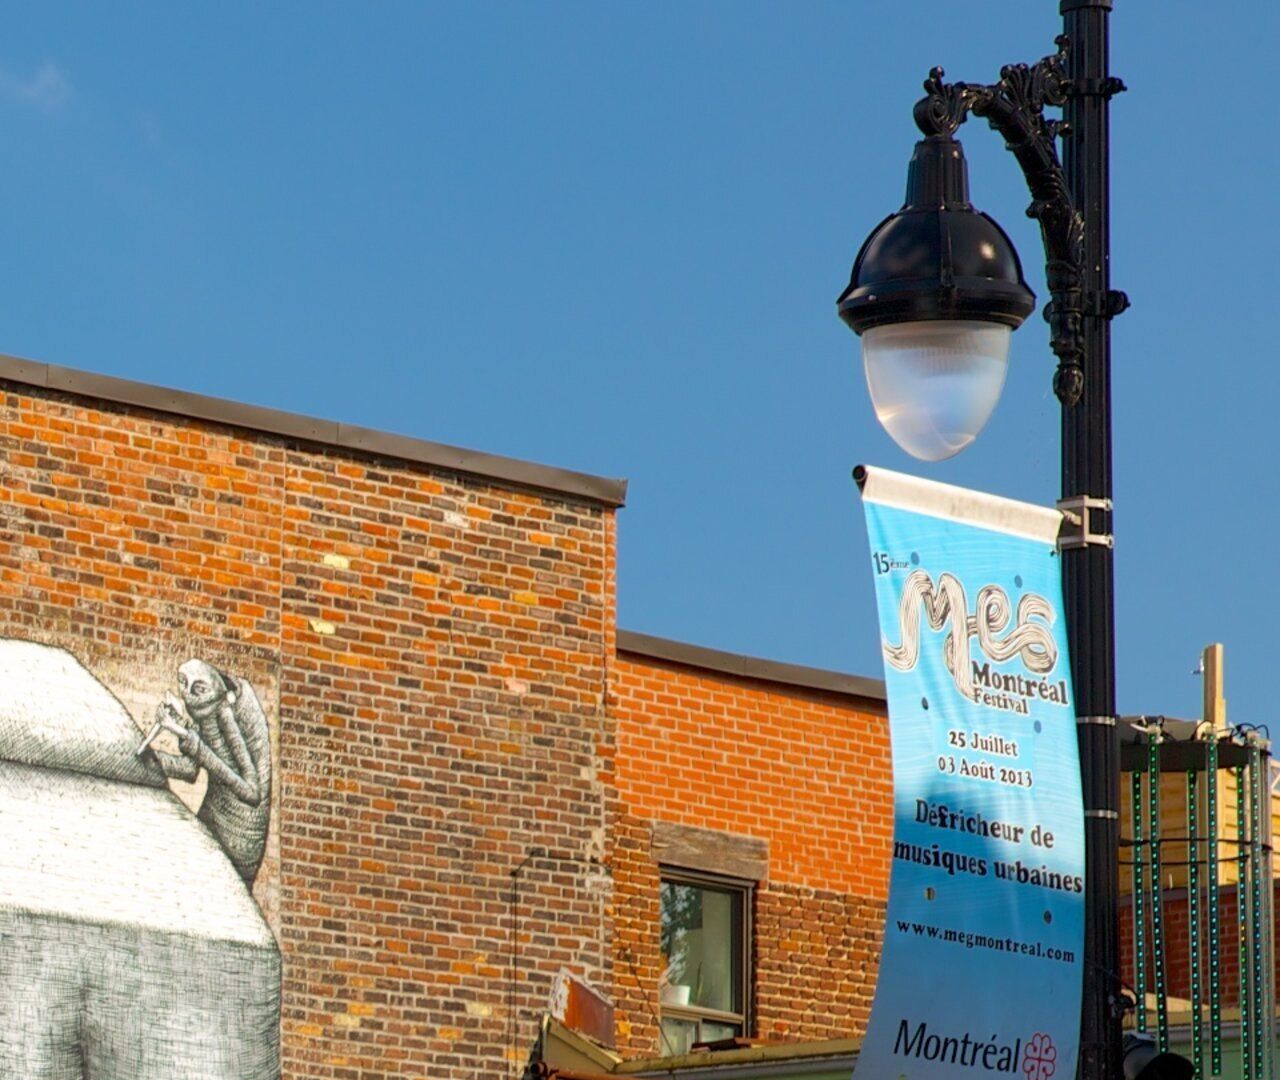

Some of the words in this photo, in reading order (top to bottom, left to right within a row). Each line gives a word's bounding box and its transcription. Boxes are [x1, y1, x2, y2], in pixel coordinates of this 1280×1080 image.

[971, 660, 1068, 705] Montréal
[973, 687, 1028, 714] Festival
[948, 731, 966, 748] 25
[970, 732, 1018, 757] Juillet
[959, 758, 995, 780] Août
[1000, 767, 1033, 788] 2013
[915, 799, 1024, 844] Défricheur
[1030, 824, 1054, 849] de
[894, 841, 988, 876] musiques
[993, 861, 1083, 894] urbaines
[897, 920, 1075, 963] www.megmontreal.com
[893, 1019, 1021, 1074] Montréal
